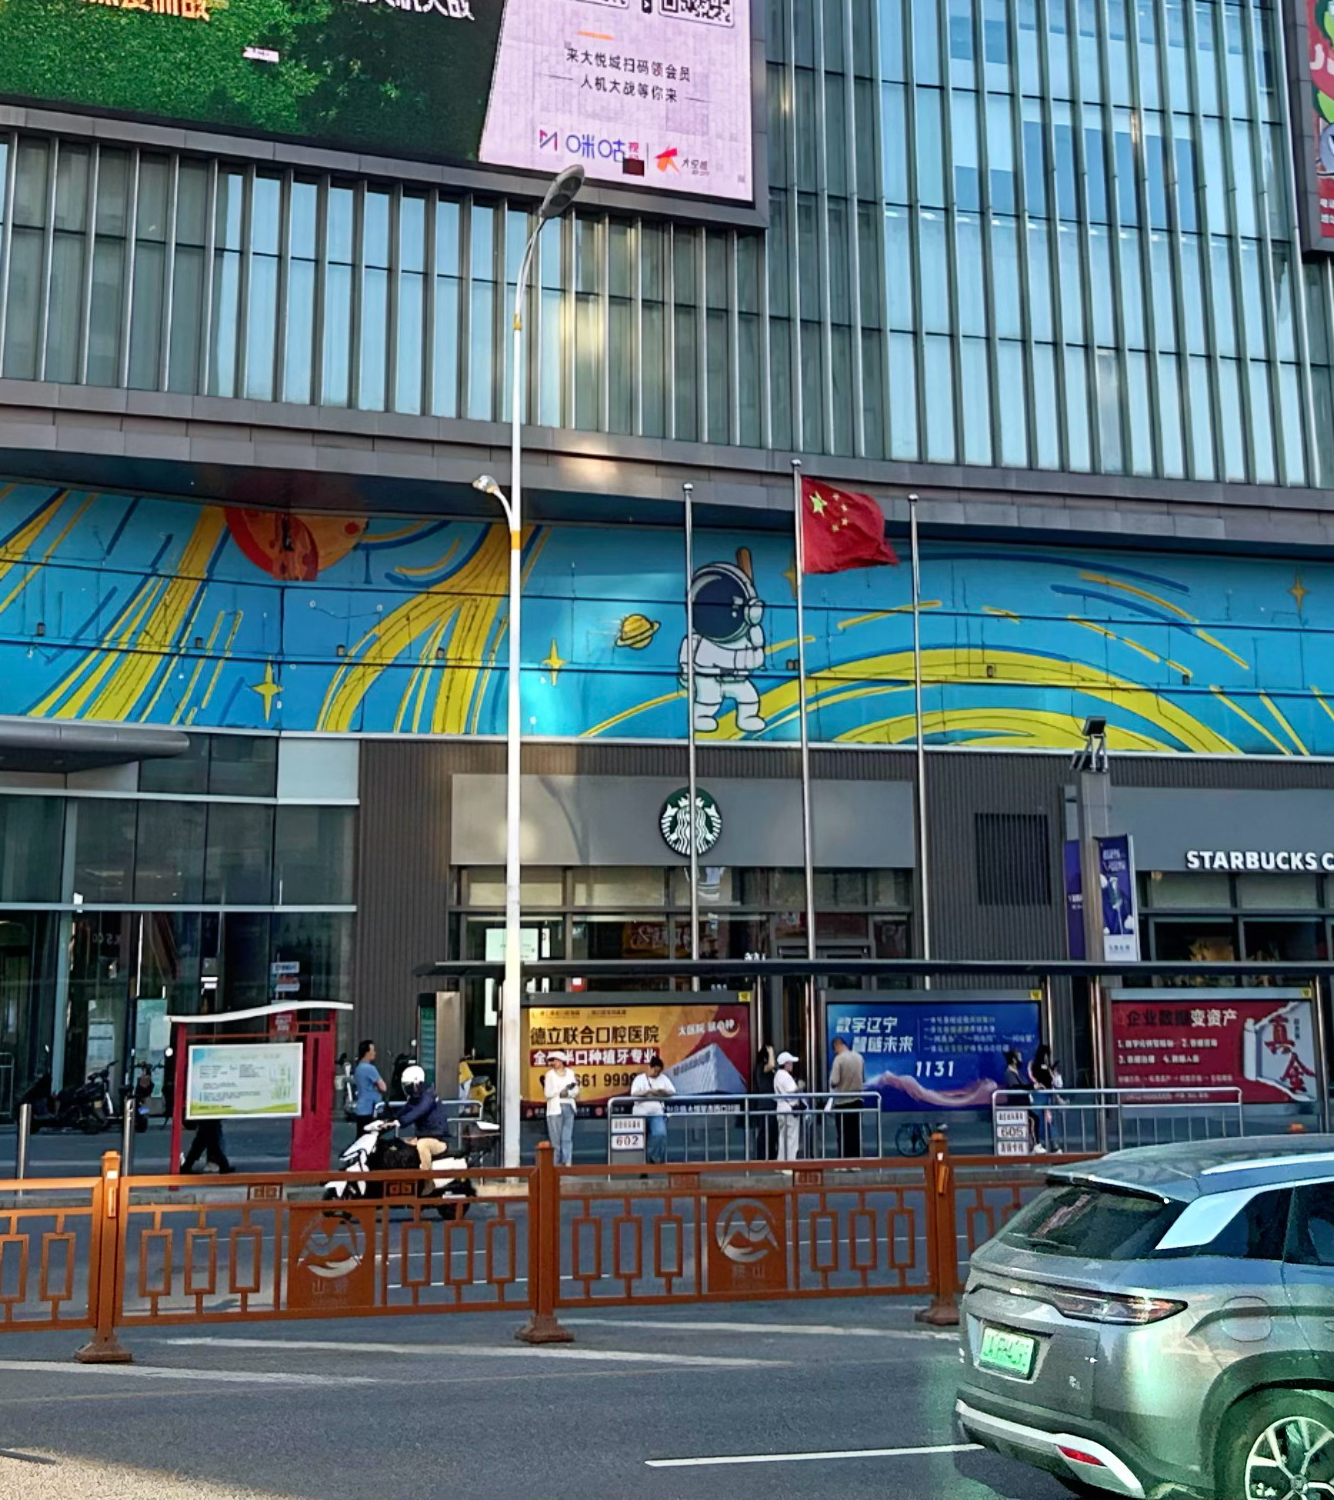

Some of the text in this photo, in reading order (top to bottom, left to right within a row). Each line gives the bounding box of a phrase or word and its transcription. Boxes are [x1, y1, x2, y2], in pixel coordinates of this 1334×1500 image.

[565, 46, 692, 84] 来大悦城扫码领会员
[579, 73, 679, 103] 人机大战等你来
[1185, 849, 1318, 873] STARBUCKS
[530, 1024, 660, 1046] 德立联合口腔医院
